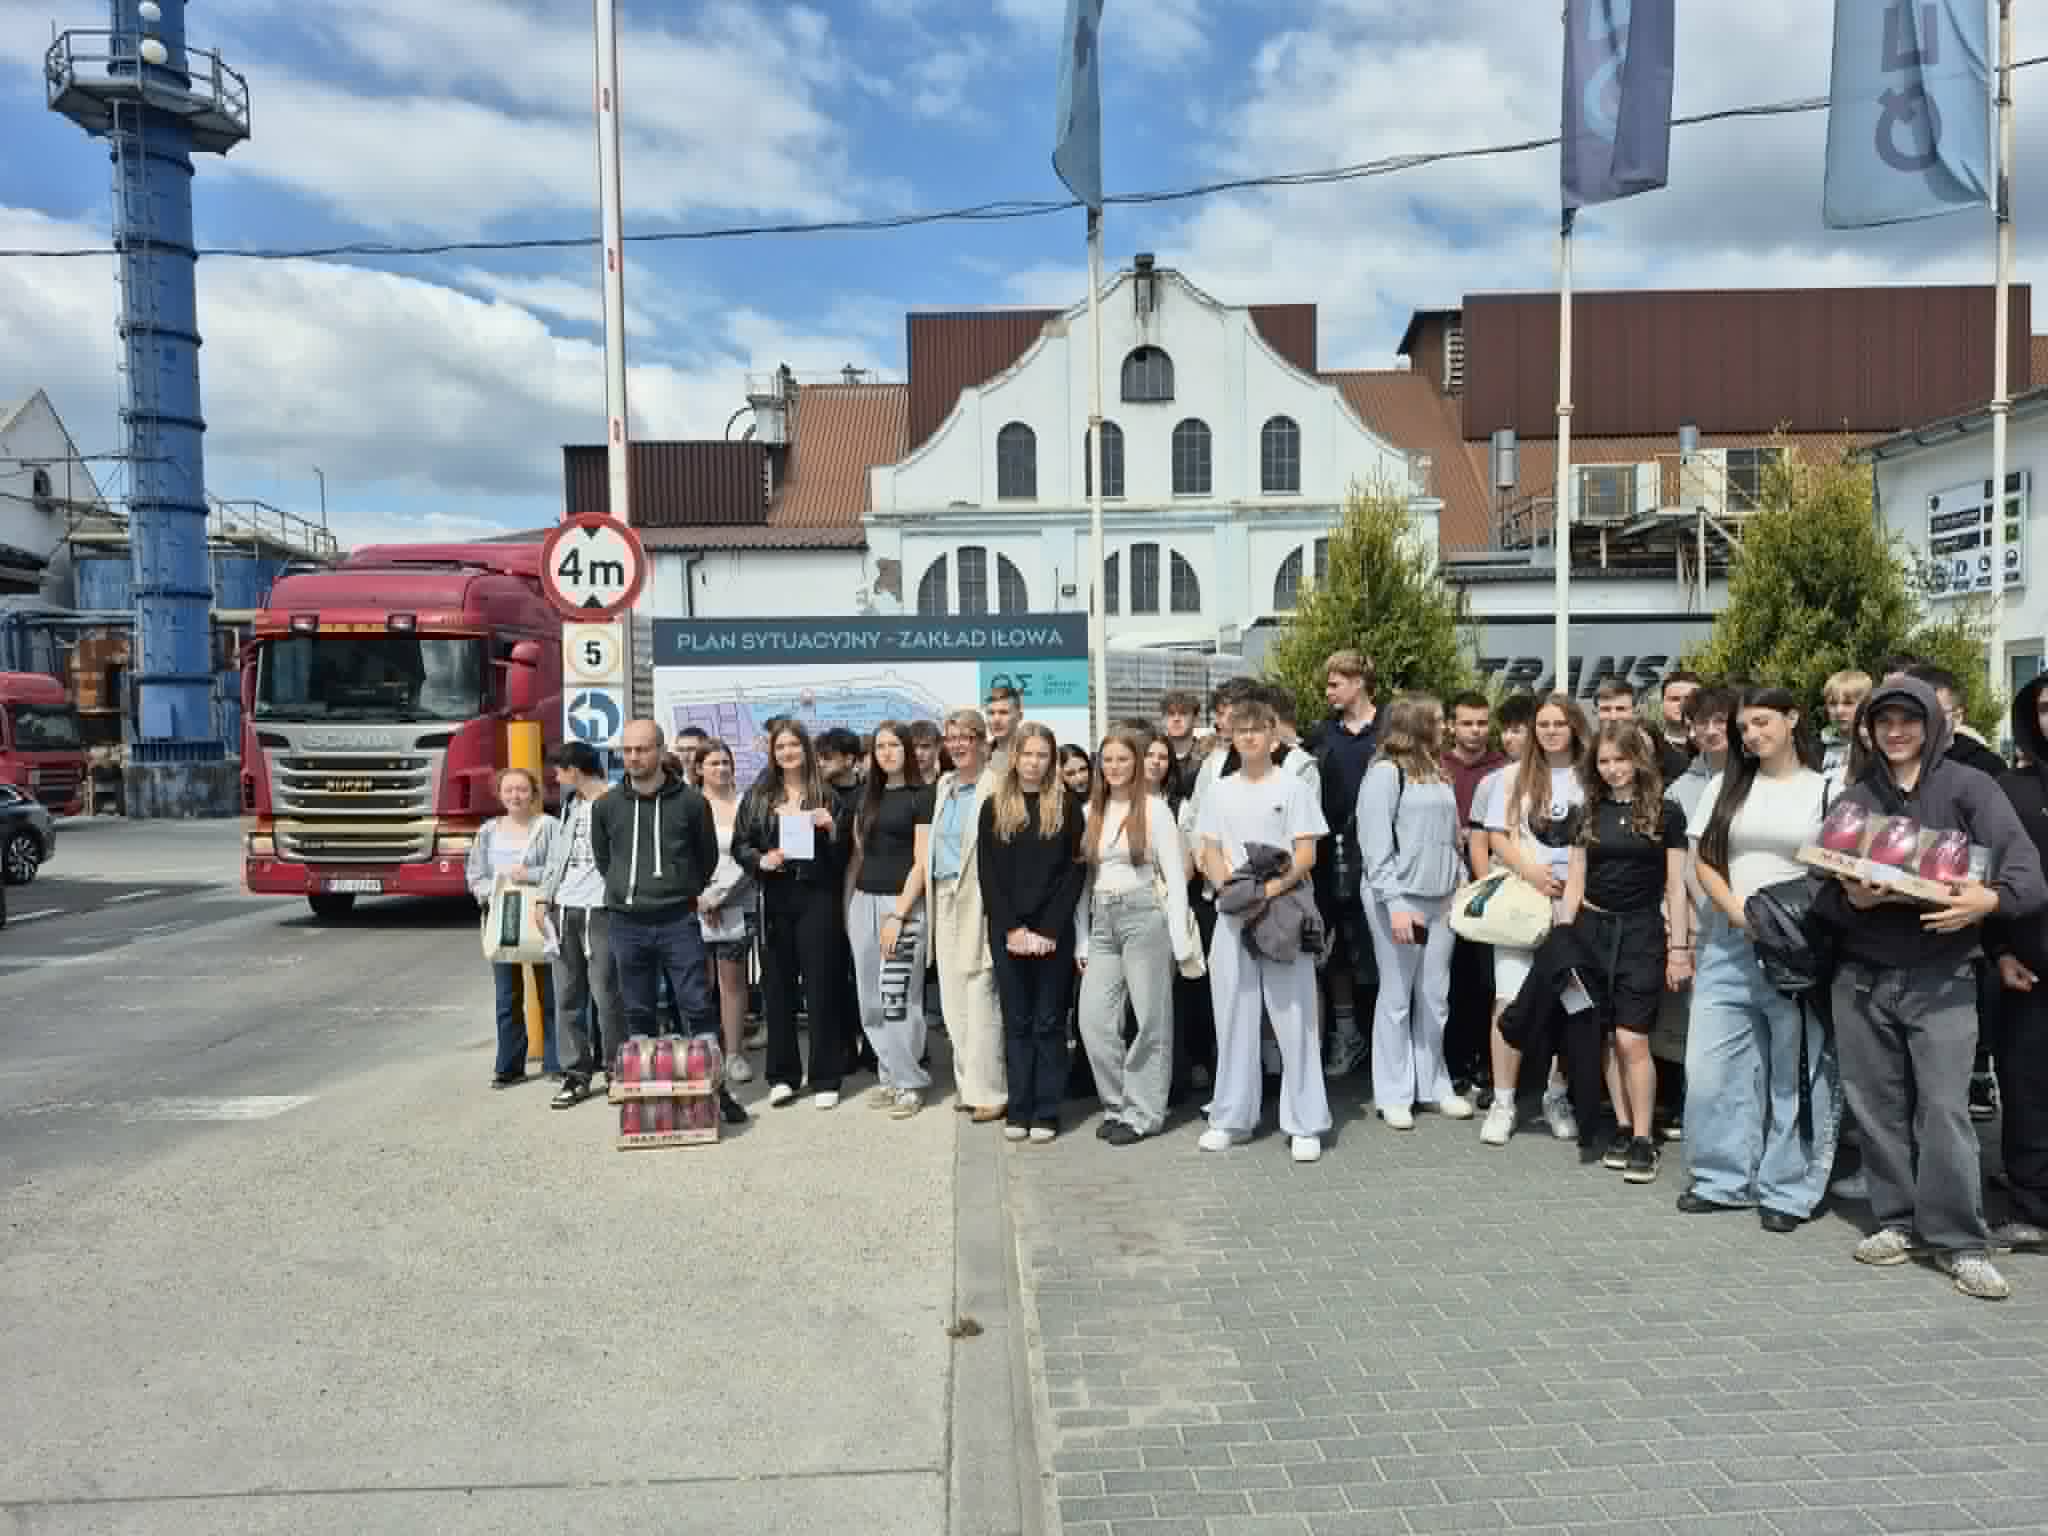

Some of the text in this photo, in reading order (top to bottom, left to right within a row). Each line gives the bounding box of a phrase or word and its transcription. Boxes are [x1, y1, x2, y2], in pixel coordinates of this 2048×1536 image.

[677, 632, 736, 650] PLAN
[741, 630, 880, 650] SYTUACYJNY
[898, 629, 987, 649] ZAKŁAD
[991, 627, 1064, 648] IŁOWA
[584, 640, 602, 666] 5
